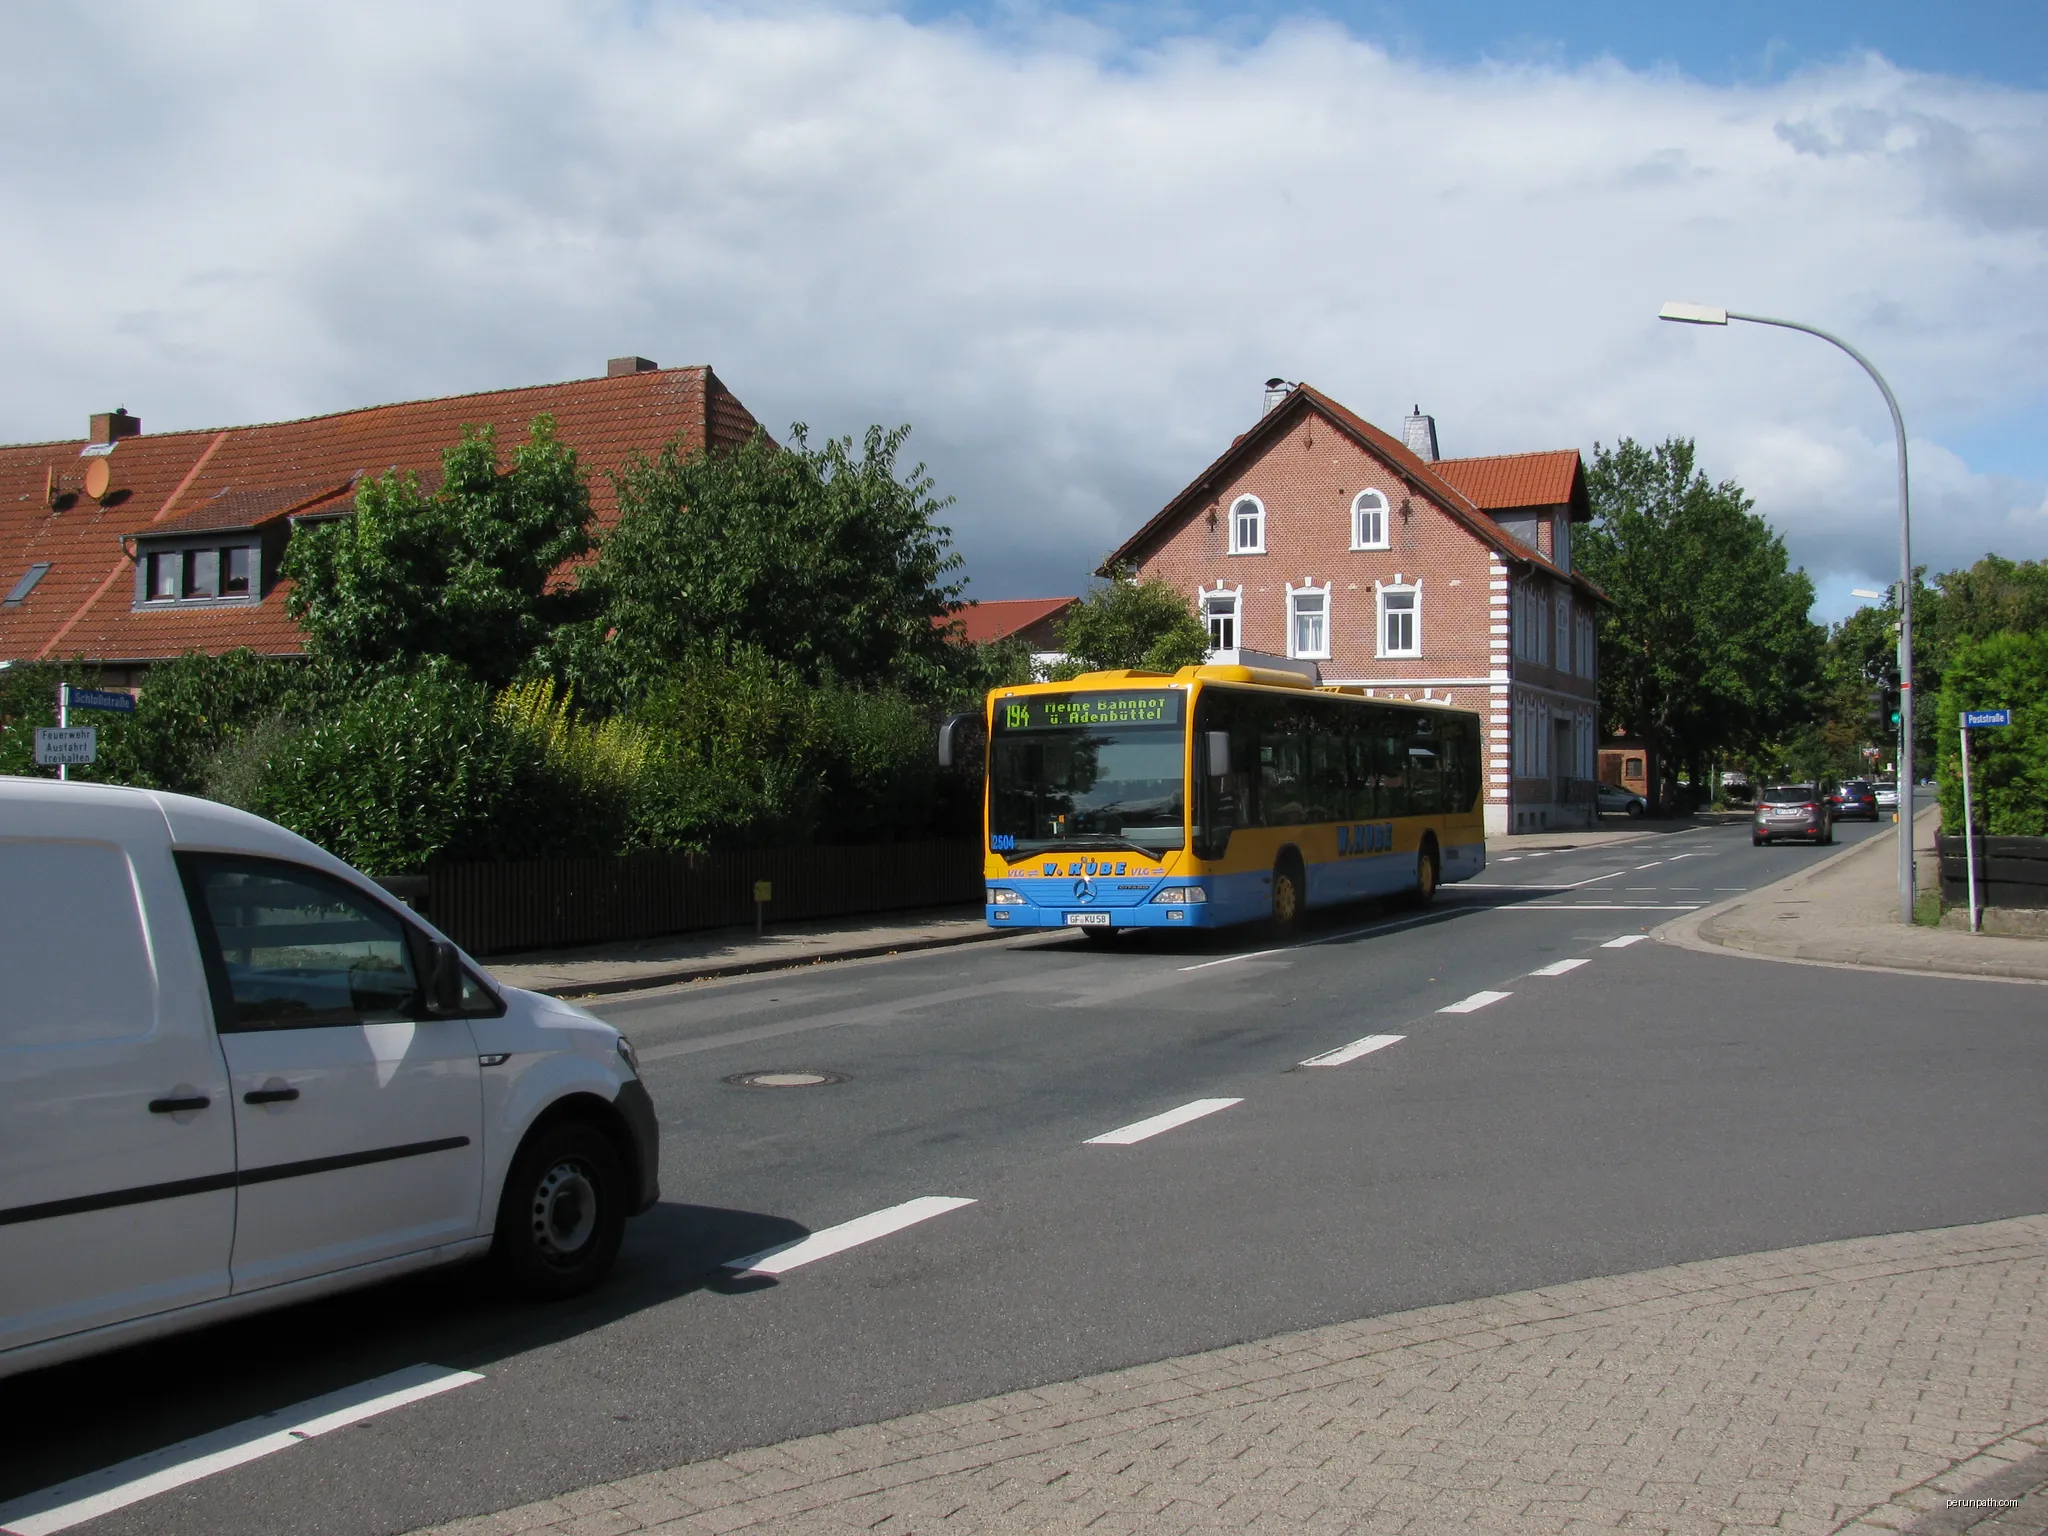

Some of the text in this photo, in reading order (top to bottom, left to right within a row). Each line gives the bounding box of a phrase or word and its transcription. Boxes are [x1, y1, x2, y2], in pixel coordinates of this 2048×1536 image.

[1006, 704, 1030, 728] 194
[1069, 707, 1161, 724] Adenbüttel
[1968, 713, 2004, 724] Poststraße
[42, 730, 90, 740] Feuerwehr
[46, 742, 87, 752] Ausfahrt
[44, 753, 90, 763] freihalten
[1008, 869, 1025, 878] VLG
[1043, 863, 1063, 876] W.
[1131, 868, 1150, 876] VLG
[1069, 915, 1081, 924] GF
